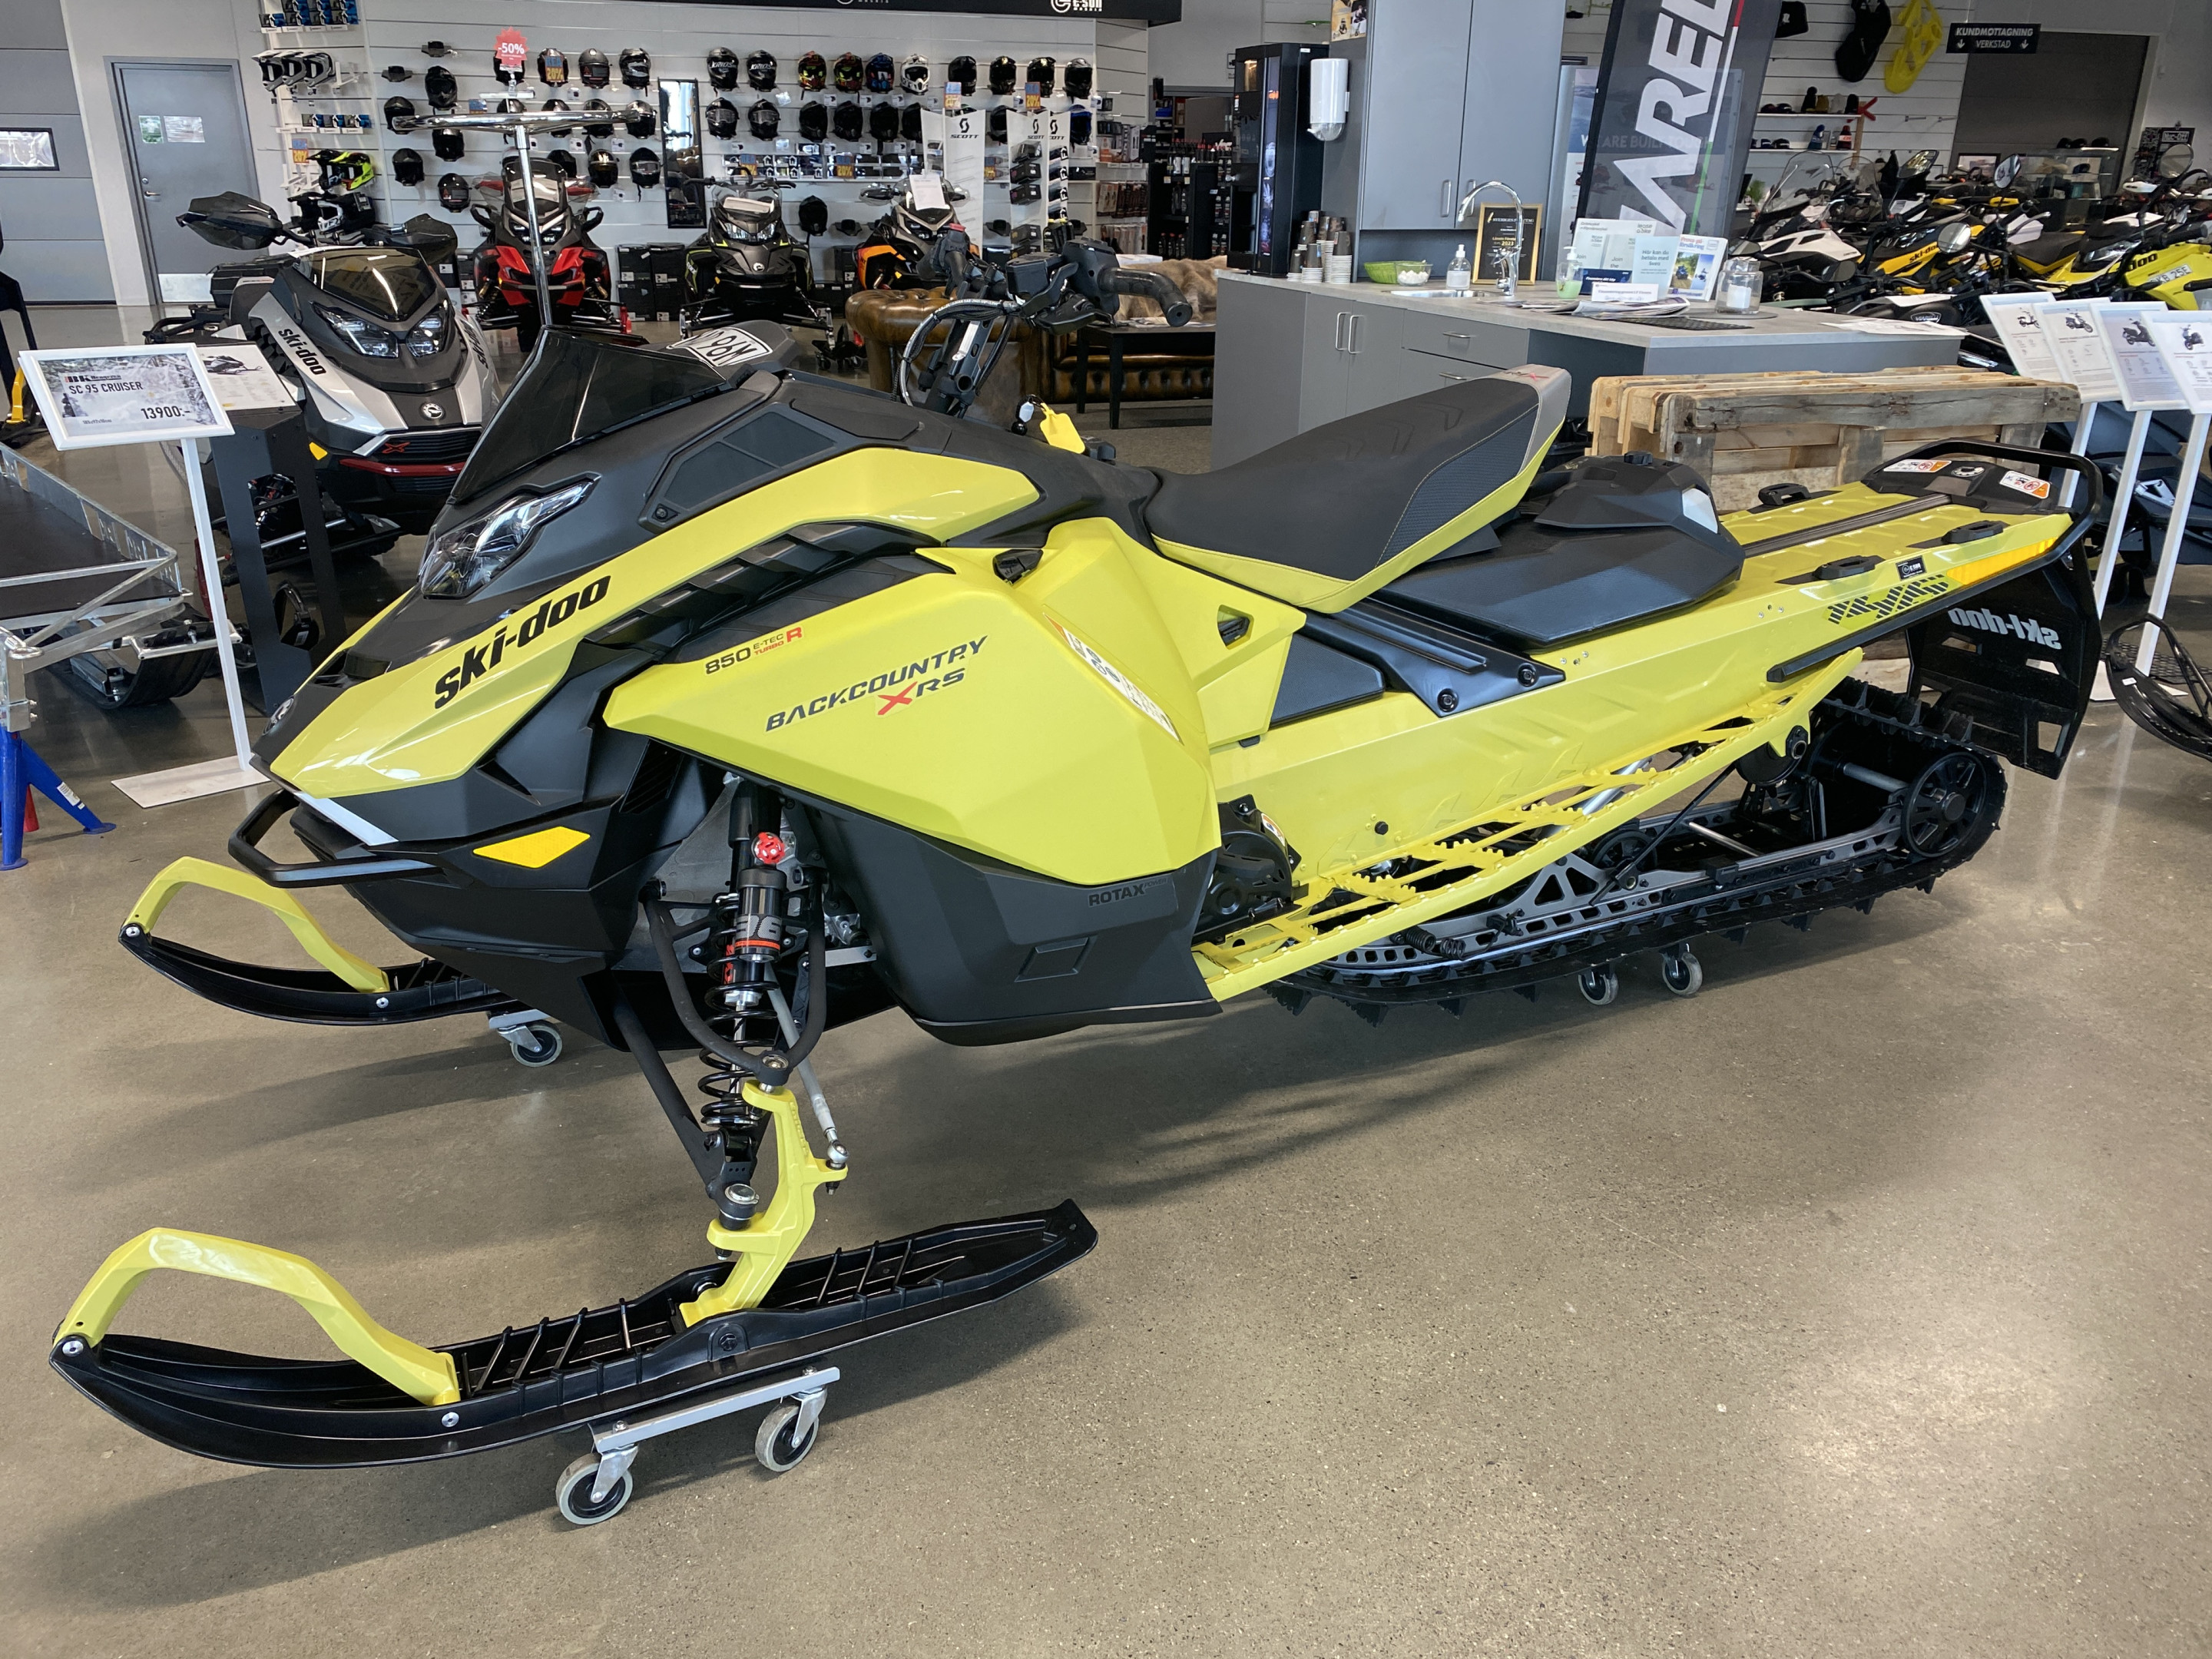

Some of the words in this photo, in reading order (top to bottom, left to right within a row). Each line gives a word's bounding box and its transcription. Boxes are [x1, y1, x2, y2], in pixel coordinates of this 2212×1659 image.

[1956, 28, 2034, 36] KUNDMOTTAGNING
[498, 42, 525, 55] -50%
[1975, 40, 2011, 48] VERKSTAD
[547, 69, 563, 80] 20%
[1909, 244, 1937, 263] ski-do
[278, 328, 326, 375] ski-doo
[69, 386, 84, 395] SC
[85, 384, 99, 393] 95
[101, 382, 144, 392] CRUISER
[141, 406, 190, 419] 13900:-
[435, 575, 611, 709] ski-doo
[754, 641, 784, 656] TURBO
[705, 647, 751, 675] 850
[753, 634, 784, 650] E-TEC
[786, 627, 803, 643] R
[766, 635, 988, 732] BACKCOUNTRY
[877, 667, 965, 715] XRS
[1088, 883, 1144, 906] ROTAX
